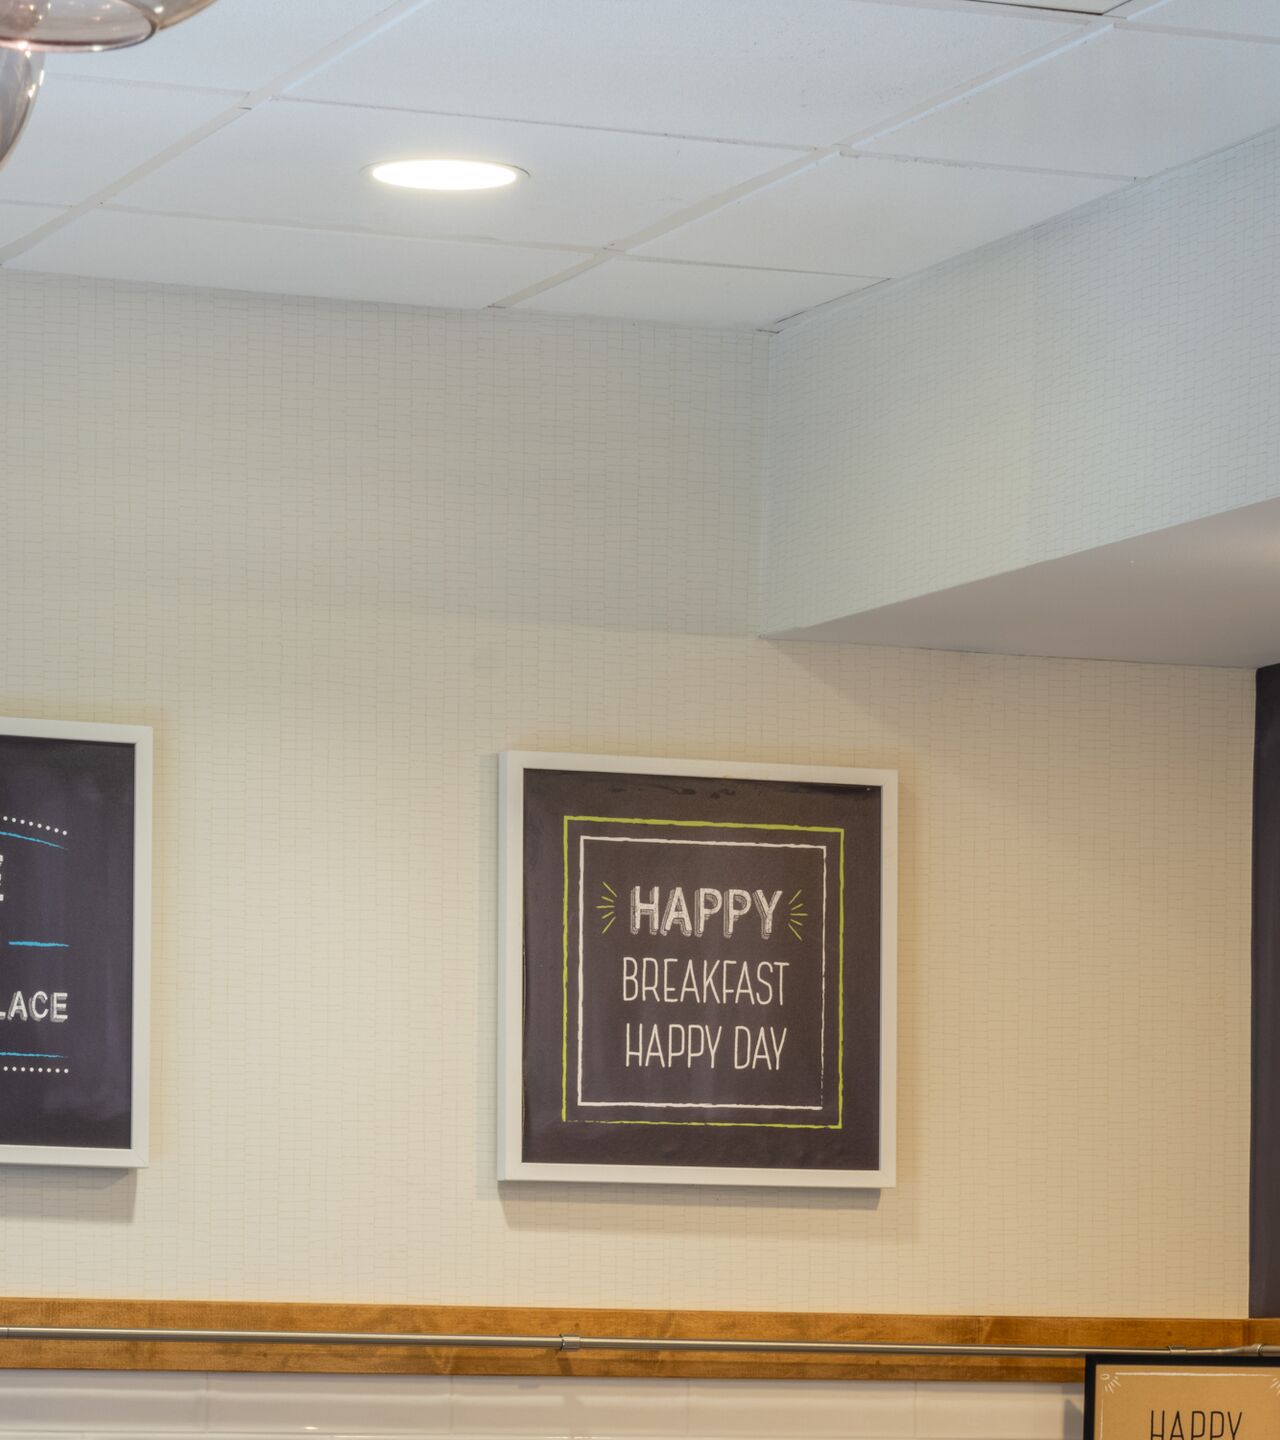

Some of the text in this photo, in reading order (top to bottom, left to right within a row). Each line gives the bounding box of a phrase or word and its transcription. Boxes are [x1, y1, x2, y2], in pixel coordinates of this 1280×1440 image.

[630, 885, 783, 940] HAPPY
[622, 956, 790, 1006] BREAKFAST
[625, 1023, 787, 1070] HAPPY DAY
